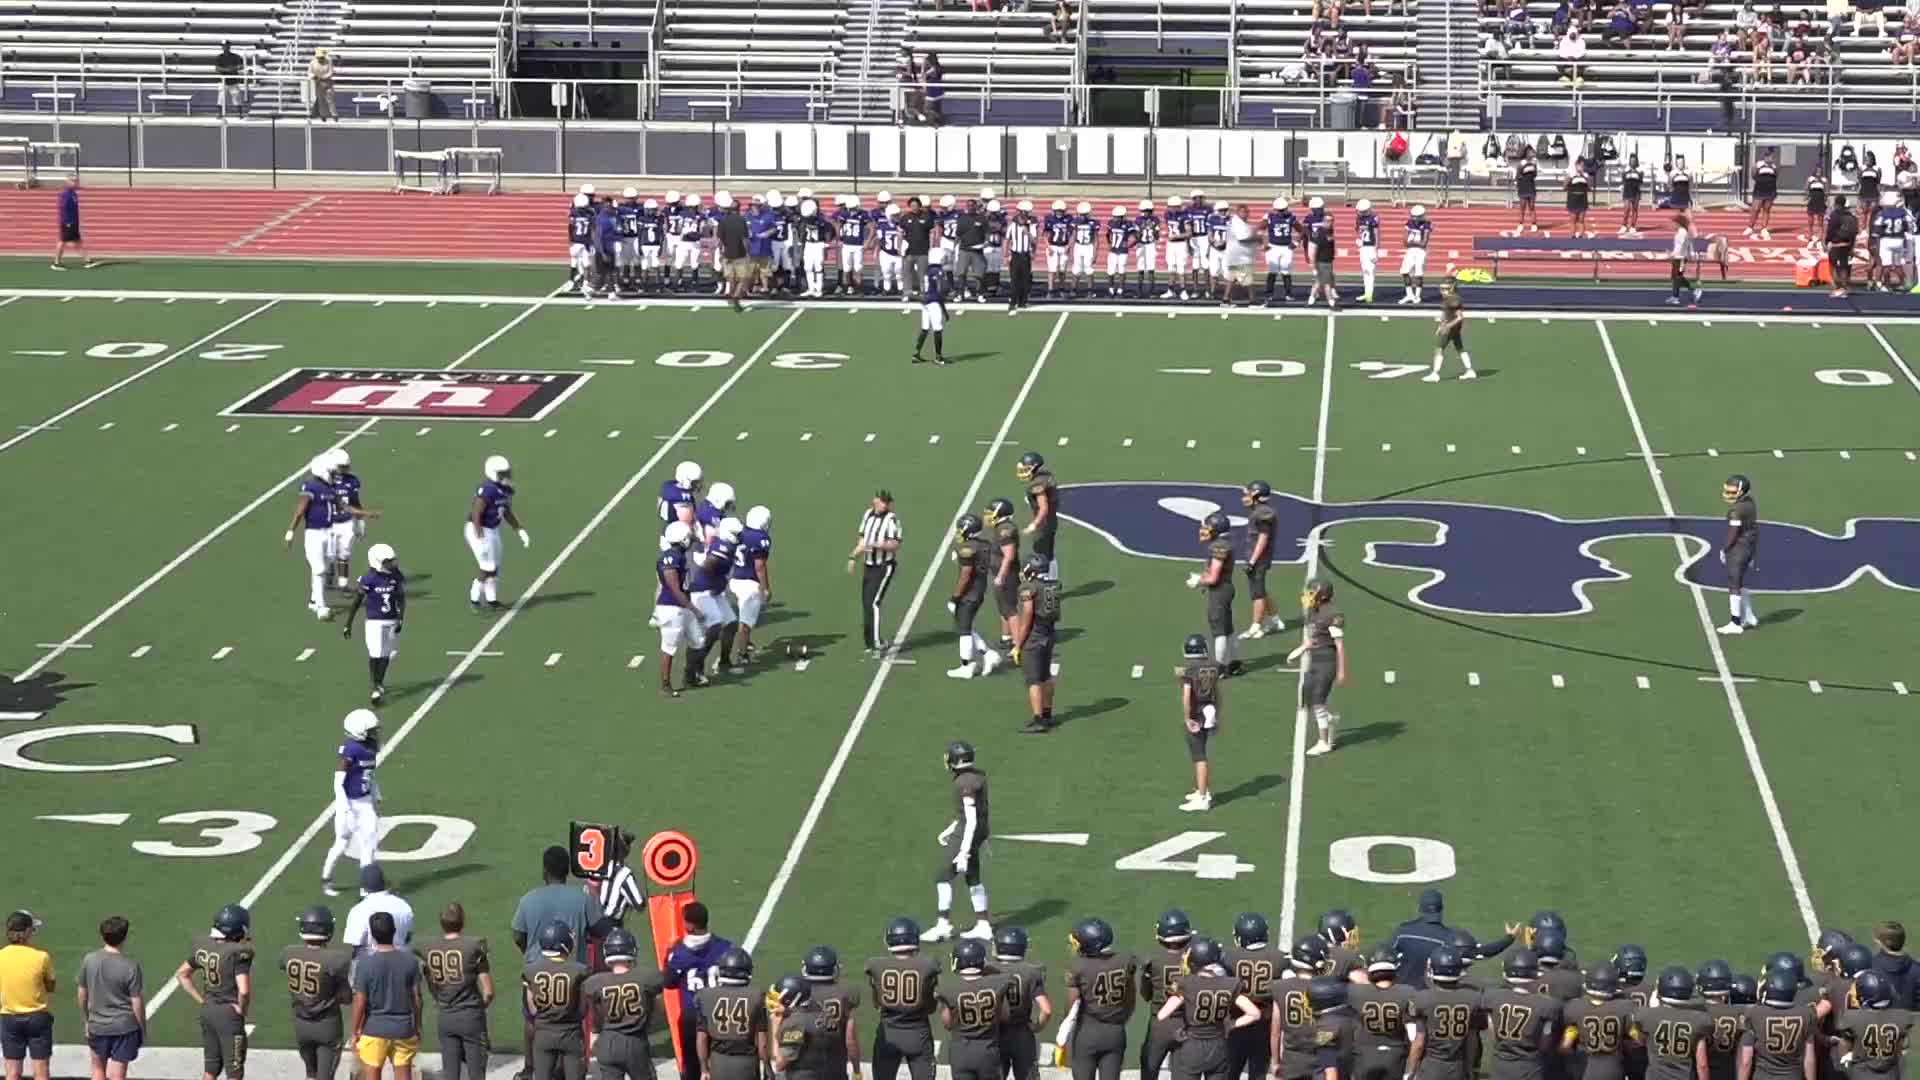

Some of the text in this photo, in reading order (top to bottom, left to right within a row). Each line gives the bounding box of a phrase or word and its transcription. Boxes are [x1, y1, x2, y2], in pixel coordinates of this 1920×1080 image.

[577, 828, 605, 871] 3
[287, 959, 321, 997] 95
[428, 950, 464, 985] 99
[534, 972, 571, 1012] 30
[602, 981, 642, 1023] 72
[881, 969, 921, 1007] 90
[1091, 968, 1126, 1006] 45
[712, 997, 750, 1033] 44
[958, 988, 997, 1028] 62
[1194, 990, 1231, 1024] 86
[1362, 1001, 1400, 1034] 26
[1433, 1003, 1470, 1040] 38
[1499, 1003, 1532, 1039] 17
[1583, 1016, 1621, 1051] 39
[1654, 1020, 1692, 1055] 46
[1766, 1016, 1803, 1052] 57
[1861, 1024, 1899, 1058] 43
